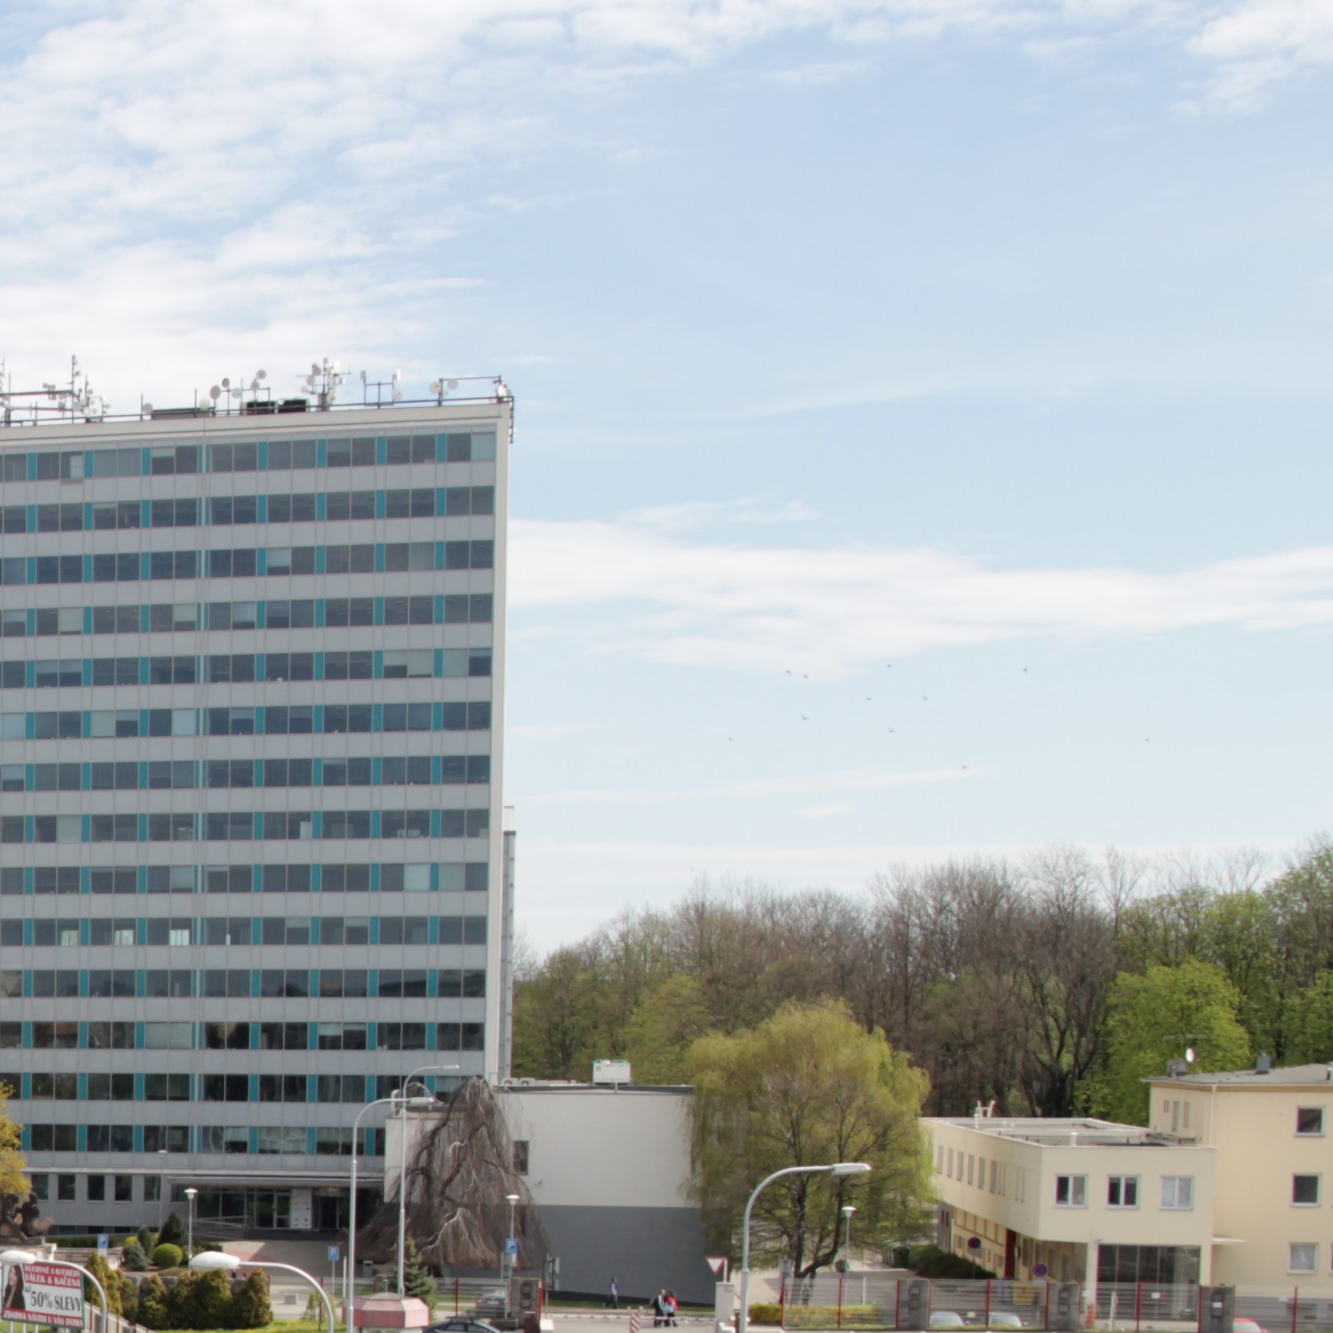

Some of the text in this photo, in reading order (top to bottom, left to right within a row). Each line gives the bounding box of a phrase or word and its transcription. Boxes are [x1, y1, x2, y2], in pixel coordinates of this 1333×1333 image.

[24, 1273, 46, 1283] VÁLEK
[30, 1291, 81, 1312] 50% SLEVY
